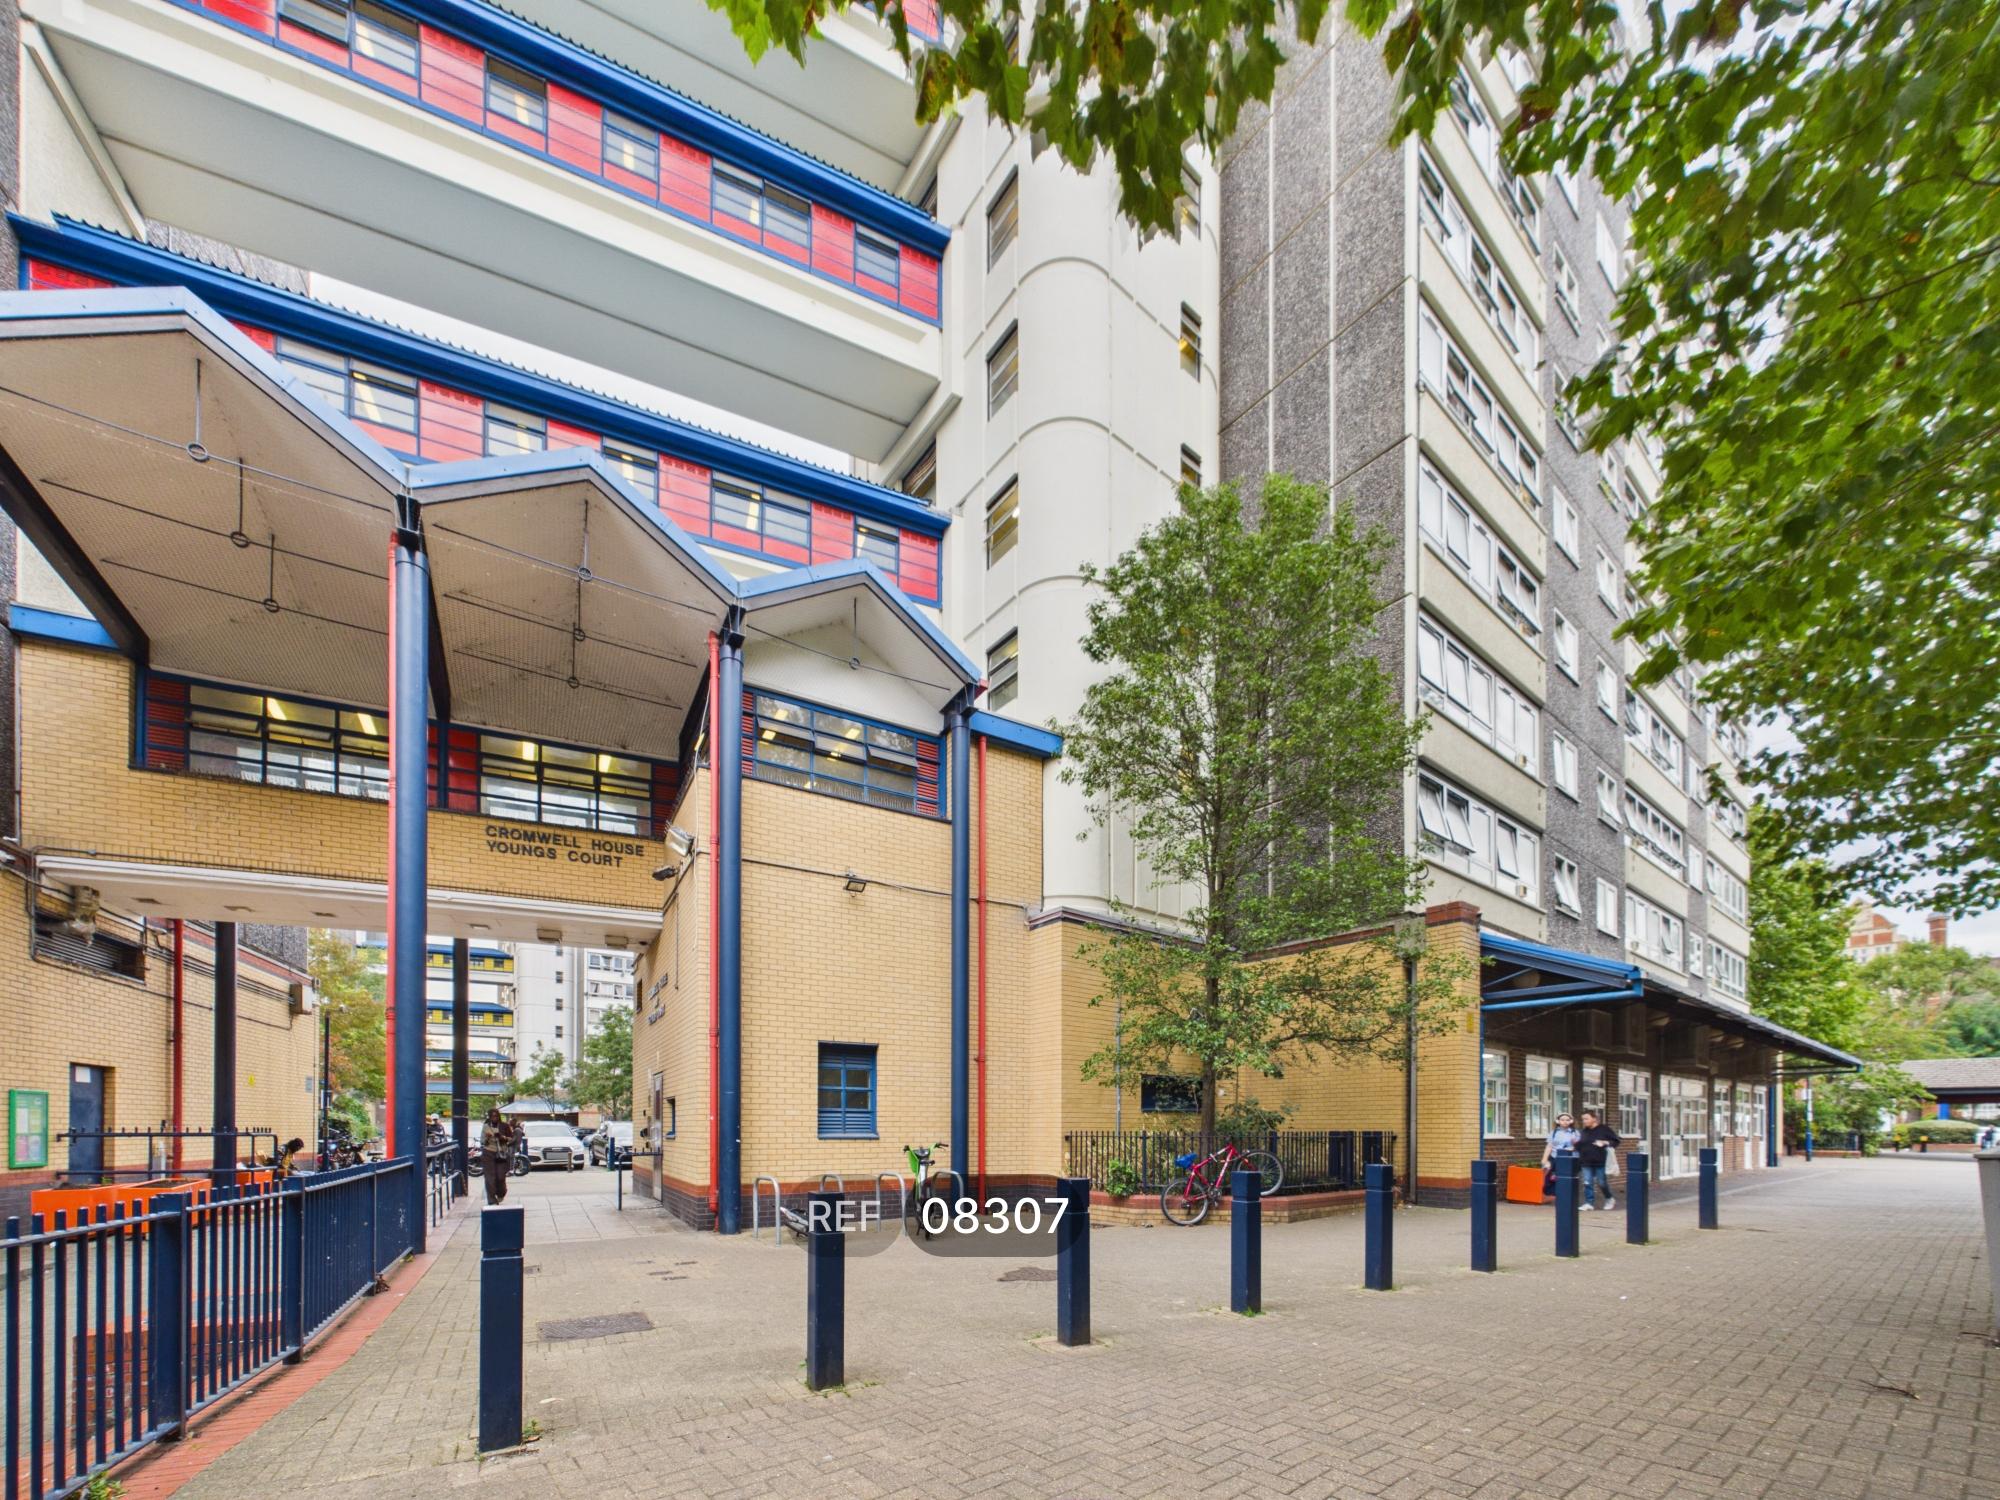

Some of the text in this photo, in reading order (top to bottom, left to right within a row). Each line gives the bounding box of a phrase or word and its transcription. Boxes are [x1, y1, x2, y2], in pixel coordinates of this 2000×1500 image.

[485, 824, 644, 857] CROMWELL HOUSE
[486, 840, 623, 868] YOUNGS COURT
